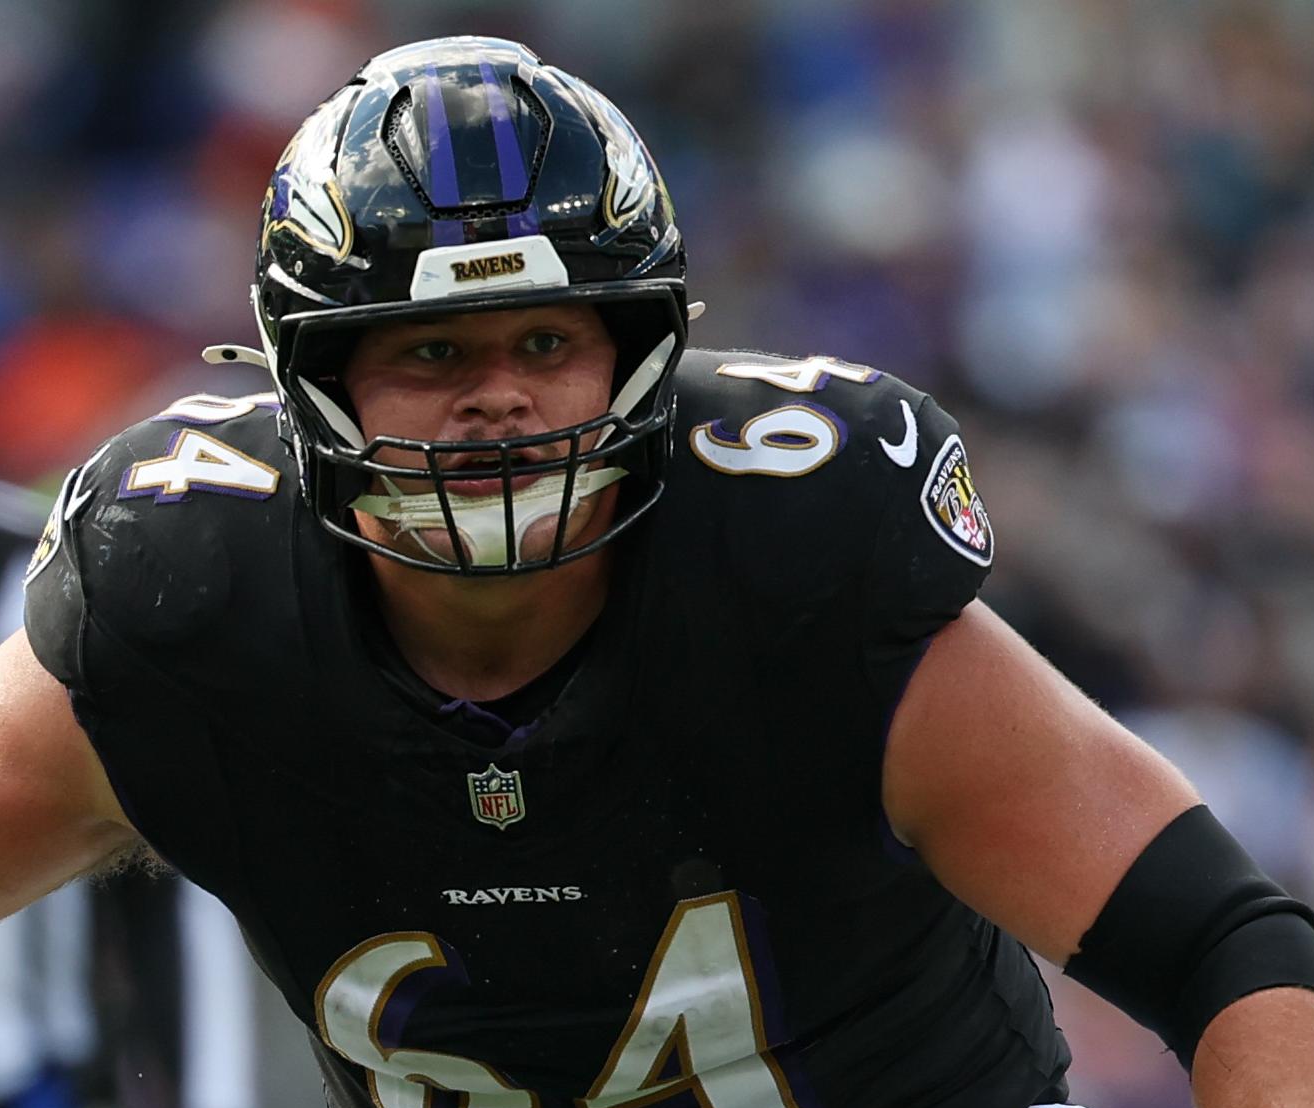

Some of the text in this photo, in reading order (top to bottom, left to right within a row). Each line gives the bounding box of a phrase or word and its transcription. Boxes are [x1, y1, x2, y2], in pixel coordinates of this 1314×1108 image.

[450, 252, 525, 282] RAVENS
[689, 356, 882, 478] 64
[930, 446, 962, 502] RAVENS
[479, 794, 517, 818] NFL
[442, 886, 582, 905] RAVENS
